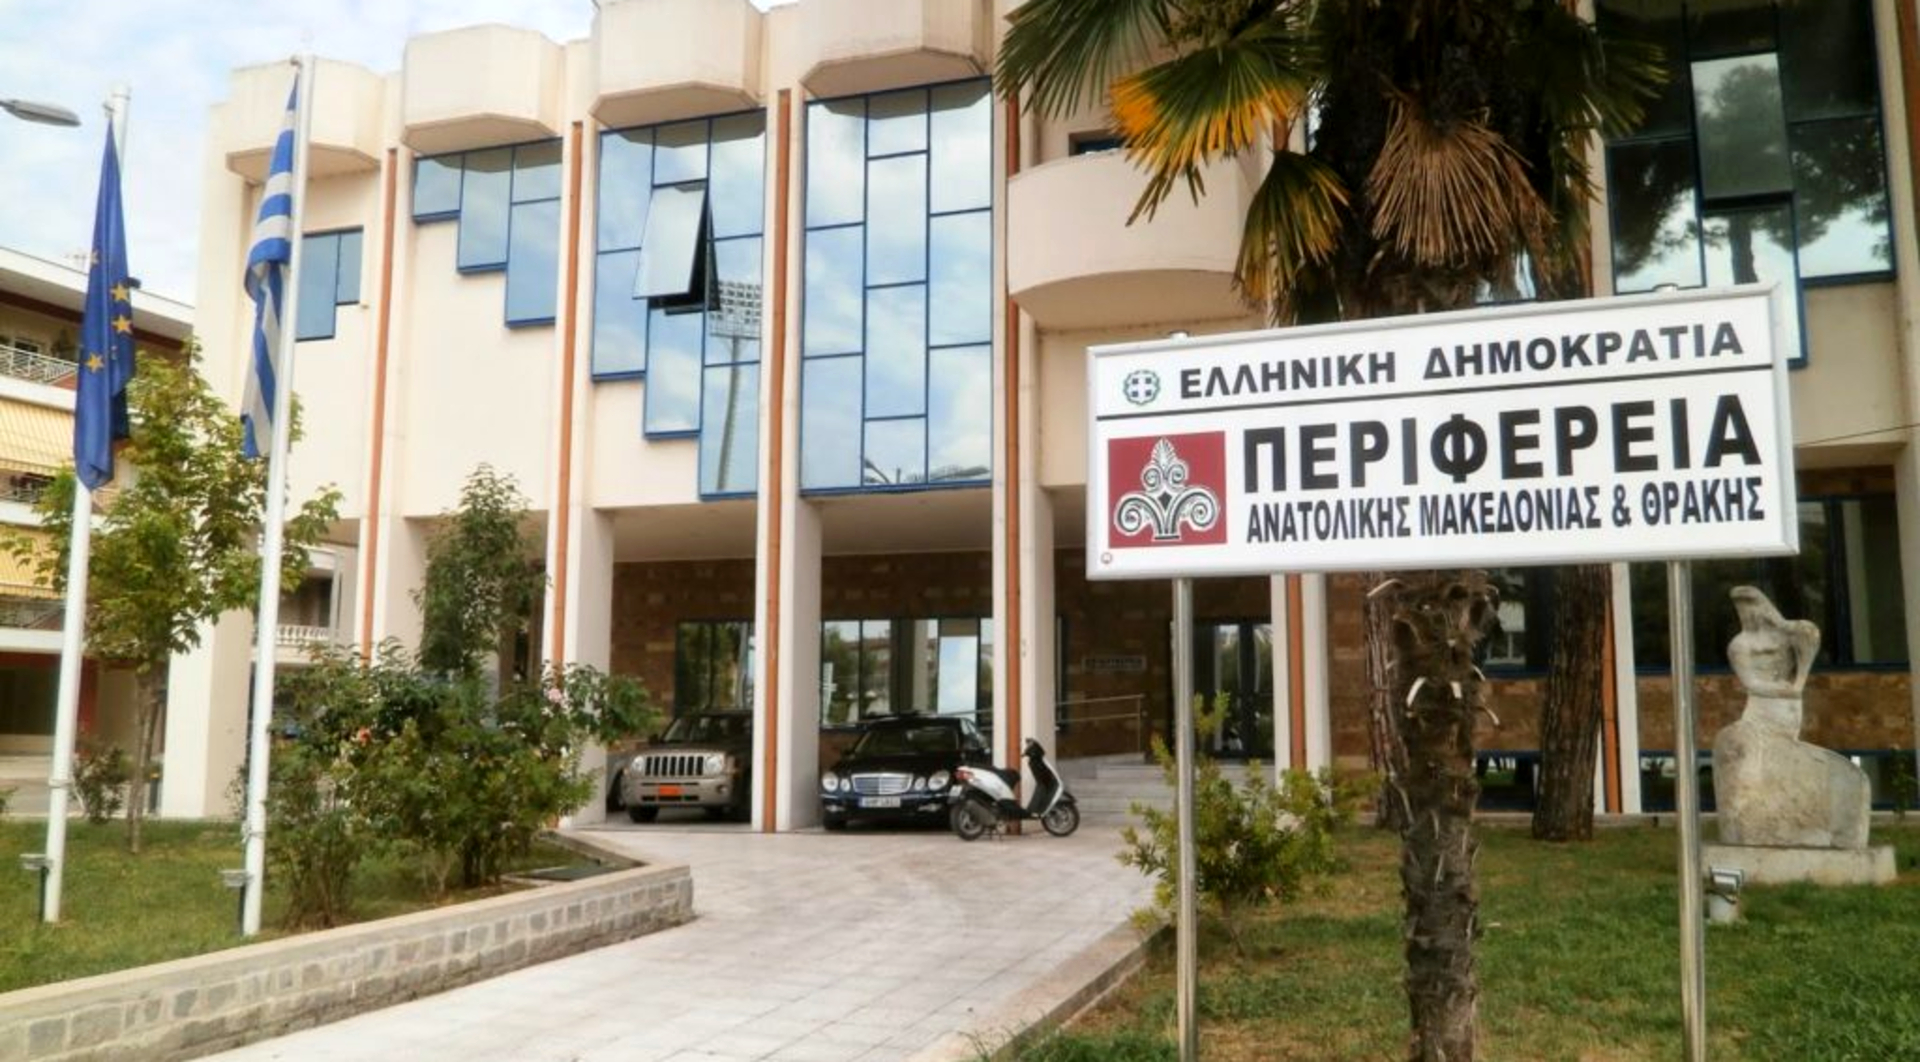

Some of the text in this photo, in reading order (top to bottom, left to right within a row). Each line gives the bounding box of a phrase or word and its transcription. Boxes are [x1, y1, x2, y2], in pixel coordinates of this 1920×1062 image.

[1180, 323, 1743, 399] ΕΛΛΗΝΙΚΗ ΔΗΜΟΚΡΑΤΙΑ
[1244, 394, 1762, 493] ΠΕΡΙΦΕΡΕΙΑ
[1247, 476, 1765, 543] ΑΝΑΤΟΛΙΚΗΣ ΜΑΚΕΔΟΝΙΑΣ & ΘΡΑΚΗΣ
